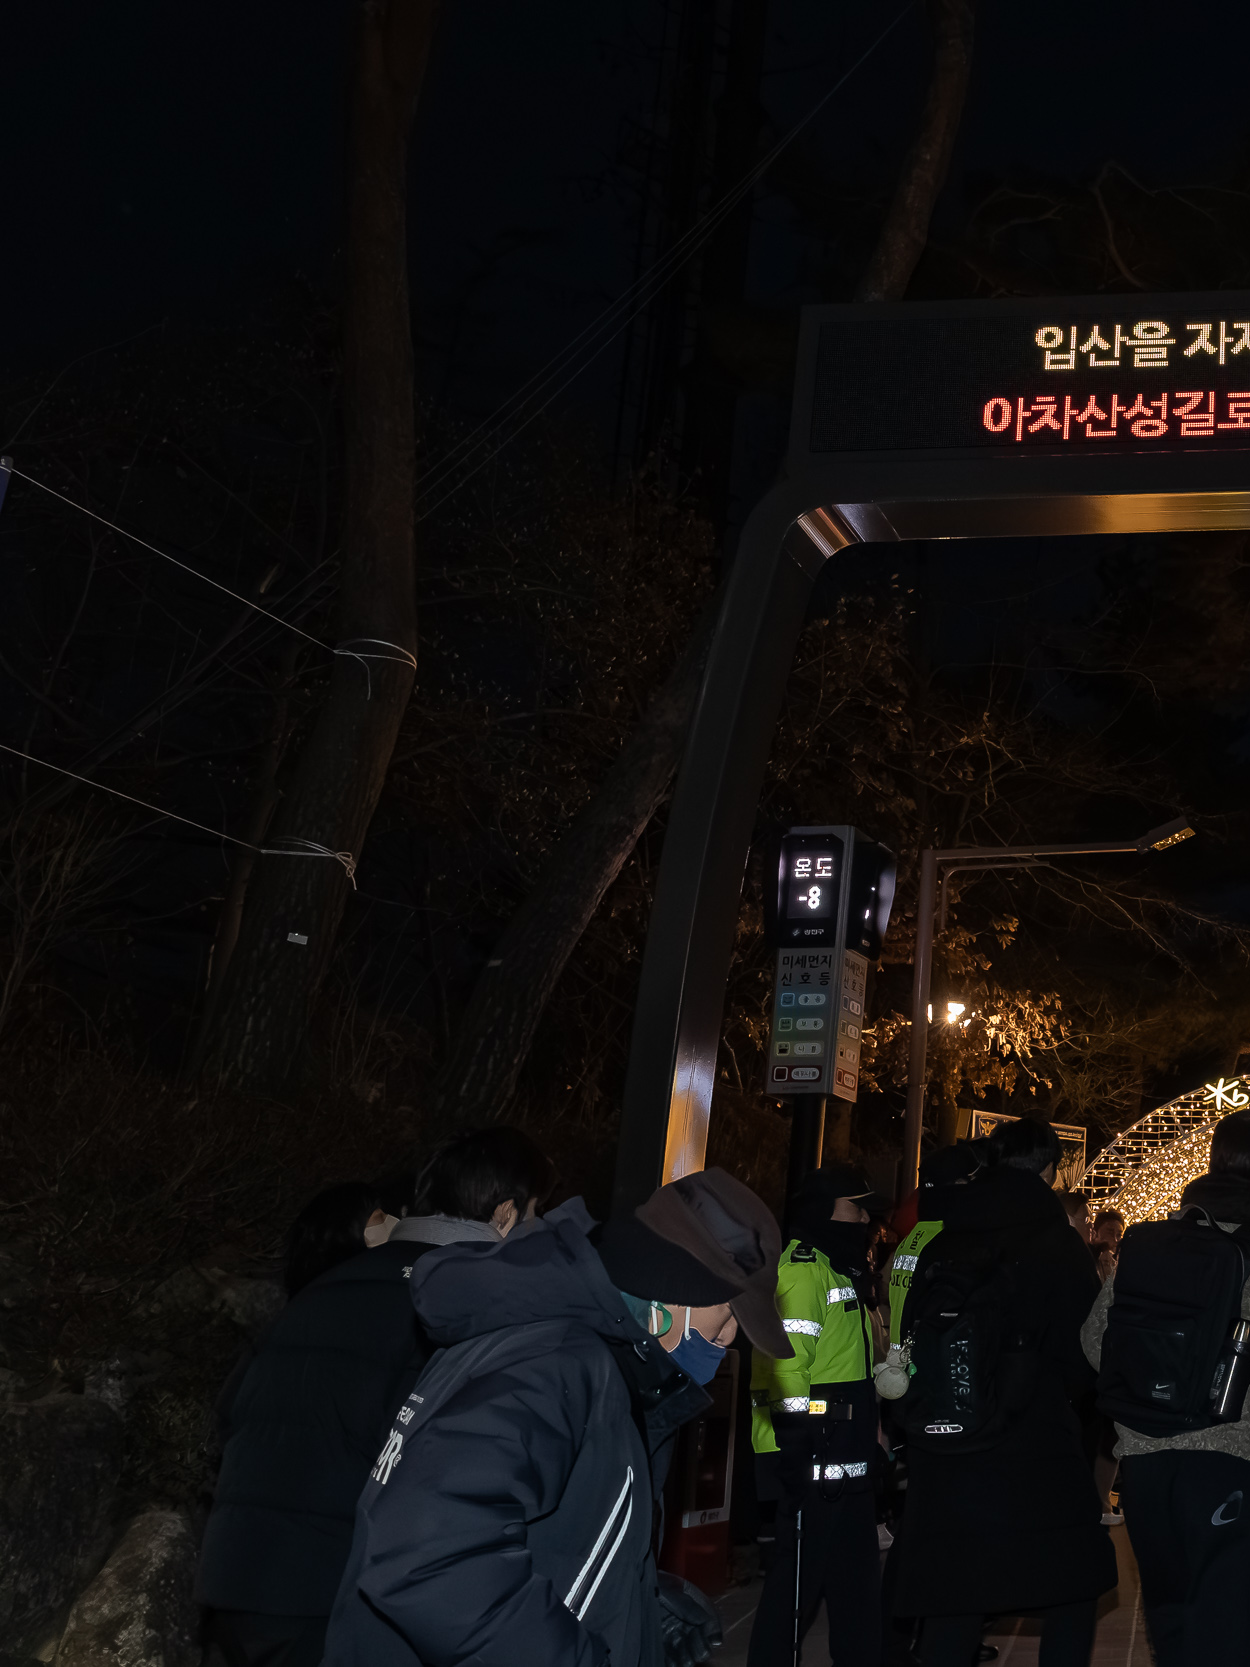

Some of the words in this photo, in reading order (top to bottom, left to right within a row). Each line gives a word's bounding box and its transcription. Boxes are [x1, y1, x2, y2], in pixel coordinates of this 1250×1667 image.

[1034, 320, 1177, 371] 입산을
[794, 857, 832, 878] 온도
[798, 885, 821, 909] -8
[782, 954, 832, 969] 미세먼지
